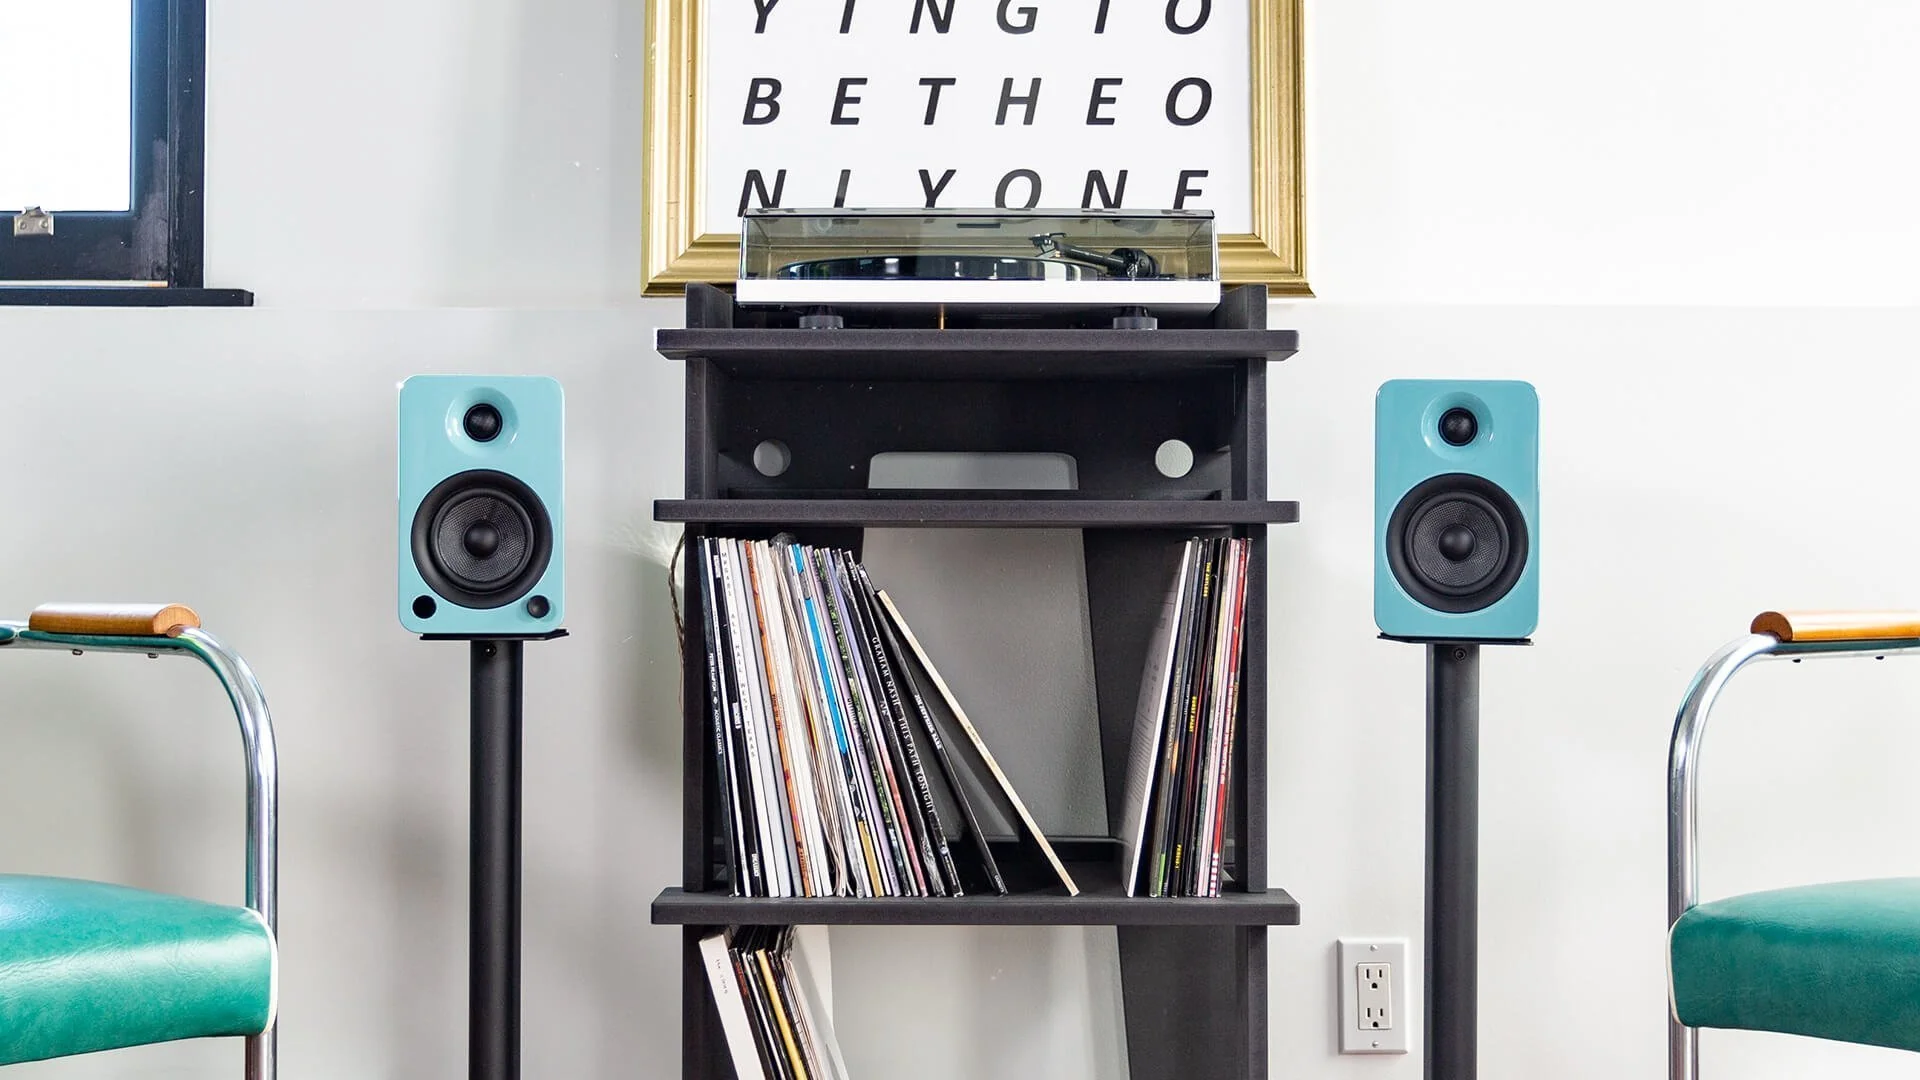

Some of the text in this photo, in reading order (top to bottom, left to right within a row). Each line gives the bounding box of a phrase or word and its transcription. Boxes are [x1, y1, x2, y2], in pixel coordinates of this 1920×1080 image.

[713, 709, 721, 732] ACOUSTIC
[870, 636, 889, 677] GRAHAM
[885, 679, 899, 706] NASH
[897, 716, 910, 739] THIS
[905, 742, 919, 766] PATH
[916, 769, 935, 814] TONIGHT
